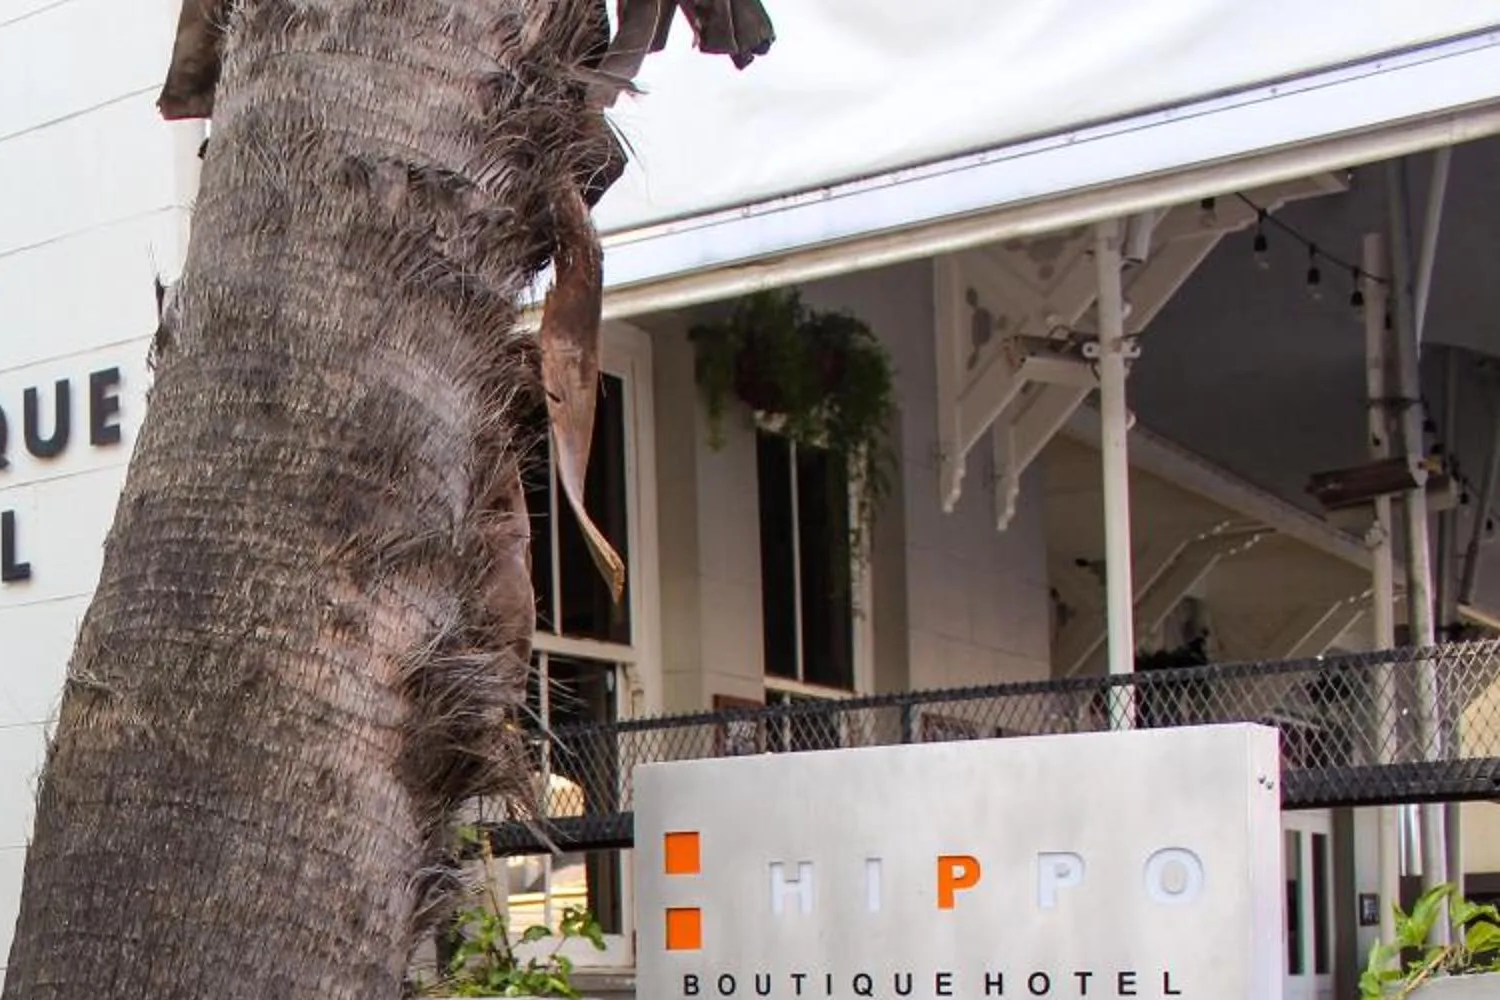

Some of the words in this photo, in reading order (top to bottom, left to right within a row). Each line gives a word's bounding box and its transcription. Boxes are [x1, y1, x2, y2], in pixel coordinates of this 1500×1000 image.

[770, 847, 1203, 914] HIPPO
[684, 971, 953, 998] BOUTIQUE
[984, 971, 1181, 996] HOTEL
